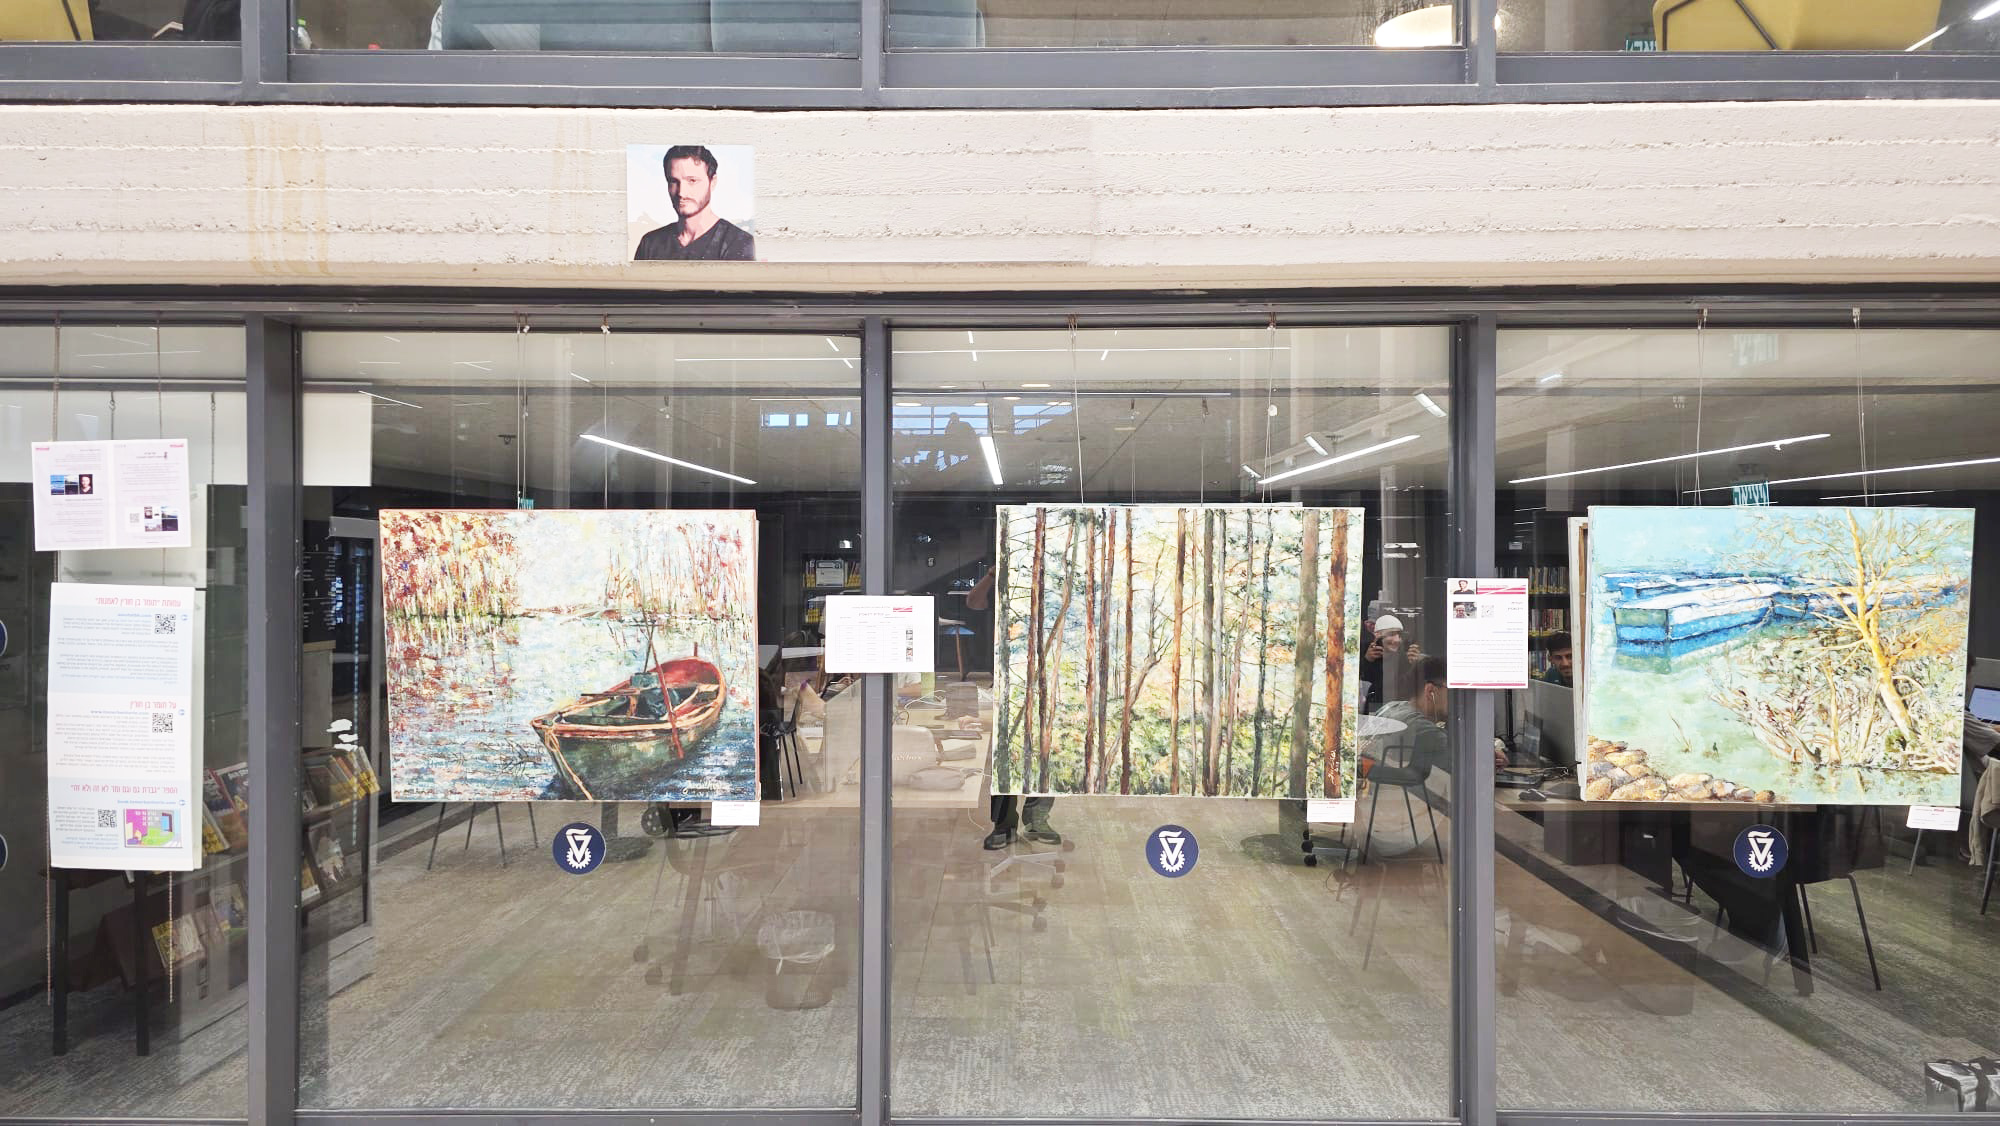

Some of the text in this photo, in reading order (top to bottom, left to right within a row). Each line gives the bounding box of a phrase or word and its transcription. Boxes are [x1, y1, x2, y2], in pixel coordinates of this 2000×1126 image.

[134, 598, 141, 608] בן
[144, 701, 151, 710] בן
[168, 700, 177, 709] על
[101, 784, 109, 793] לא
[162, 786, 178, 794] הספר
